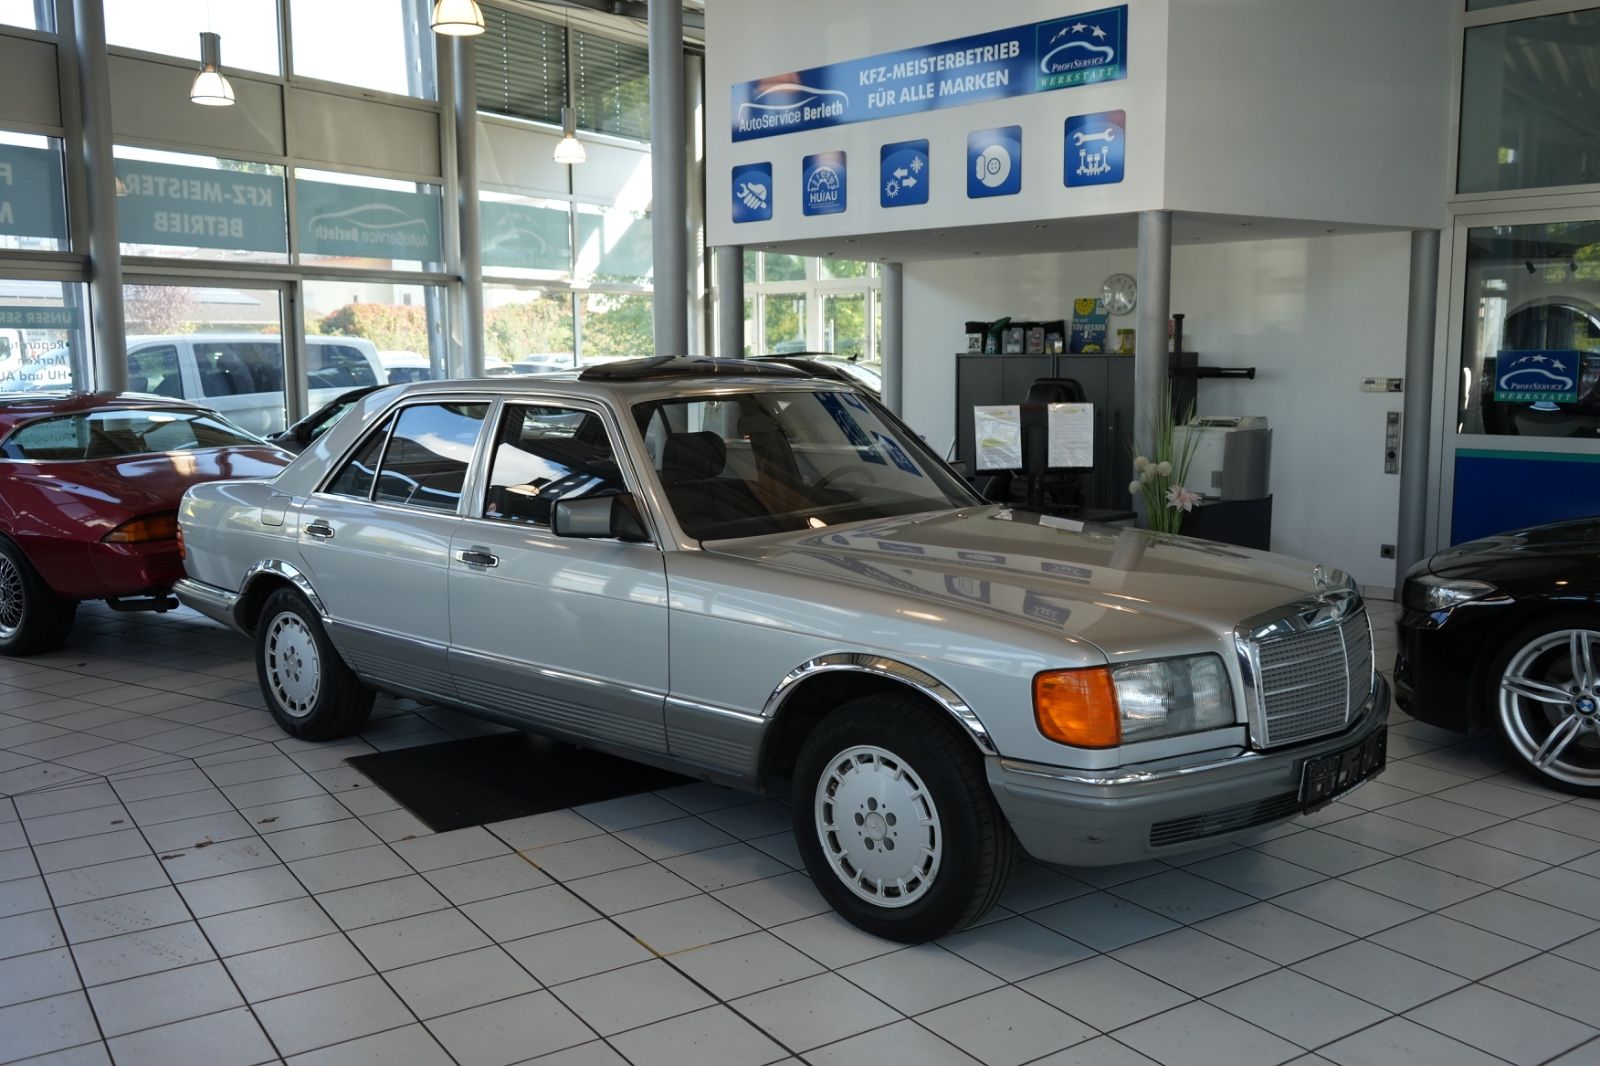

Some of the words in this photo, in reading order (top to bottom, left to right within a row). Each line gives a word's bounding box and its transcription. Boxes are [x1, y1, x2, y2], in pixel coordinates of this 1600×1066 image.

[859, 41, 1020, 86] KFZ-MEISTERBETRIEB
[868, 87, 896, 109] FÜR
[900, 82, 935, 103] ALLE
[939, 69, 1009, 97] MARKEN
[1041, 67, 1113, 86] WERKSTATT
[739, 108, 801, 132] AutoService
[803, 100, 843, 121] Berleth
[810, 190, 838, 203] HU/AU
[1500, 392, 1572, 401] WERKSTATT
